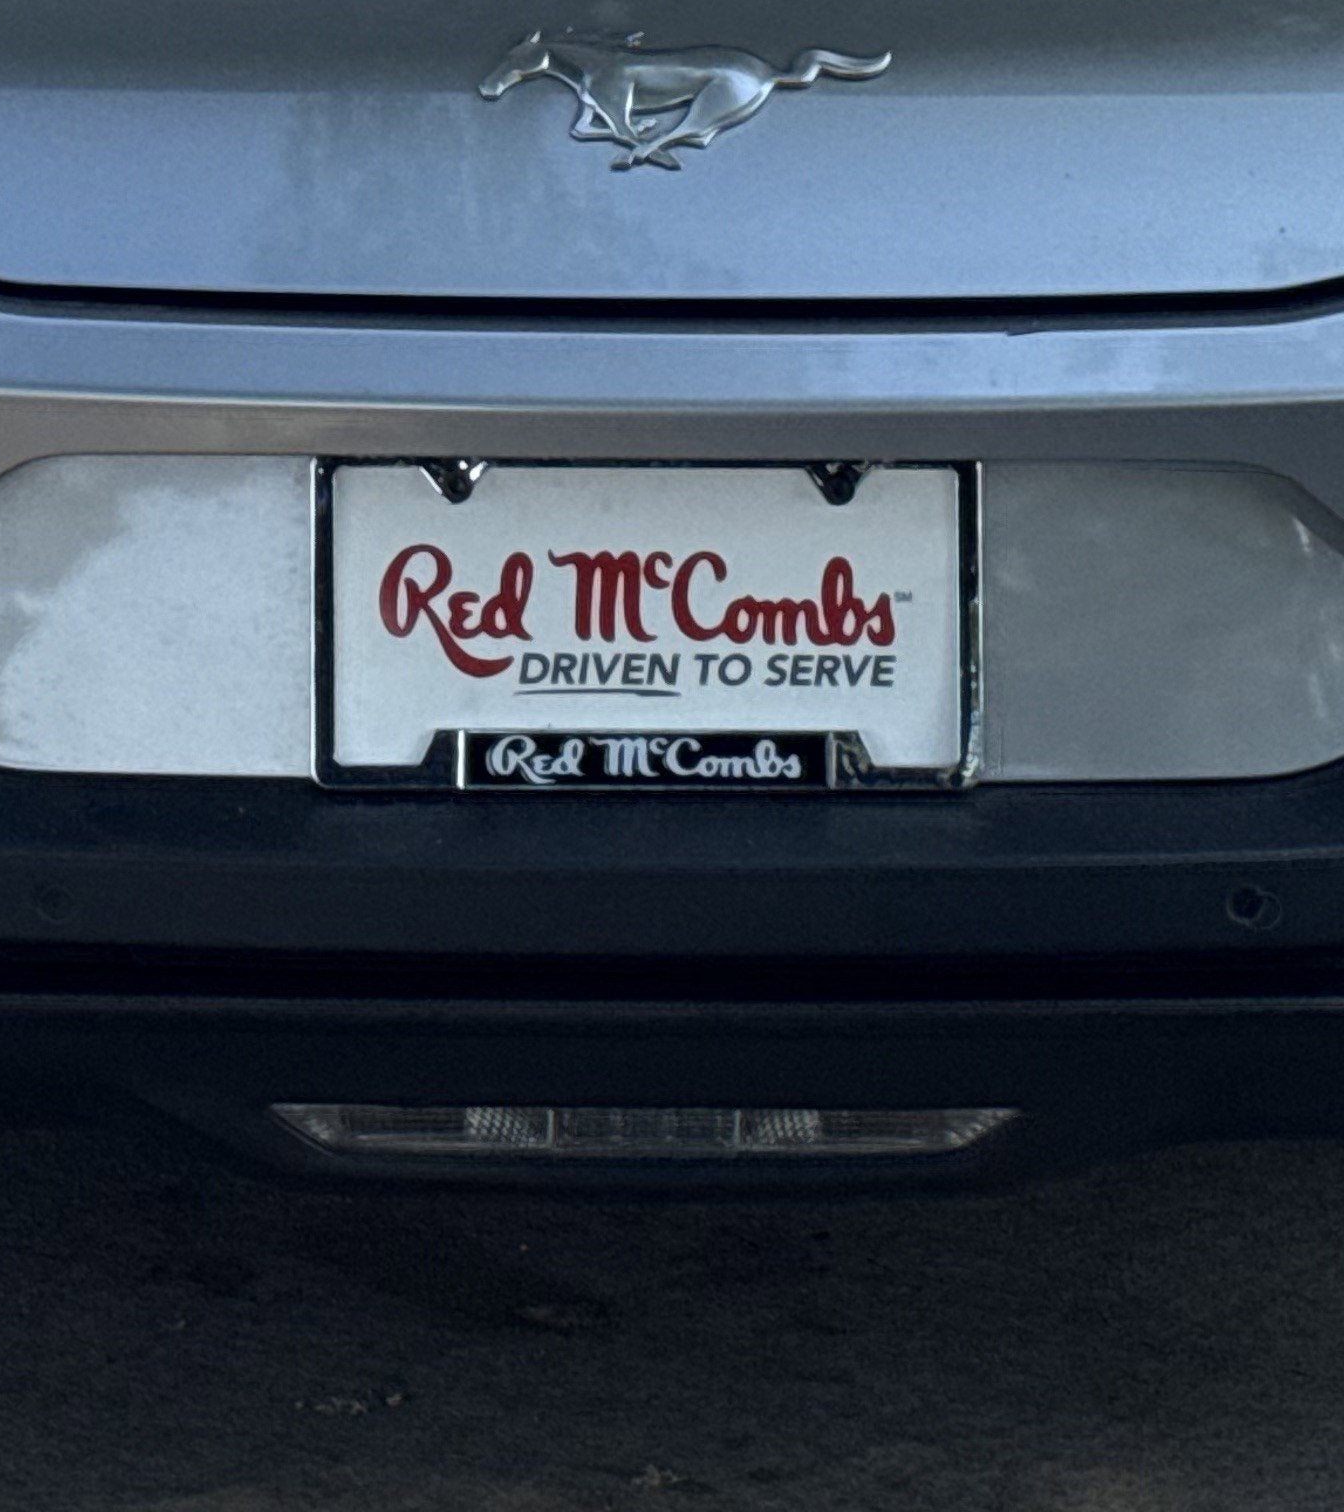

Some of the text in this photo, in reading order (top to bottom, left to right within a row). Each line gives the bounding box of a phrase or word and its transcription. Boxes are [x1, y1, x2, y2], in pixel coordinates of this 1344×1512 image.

[379, 544, 533, 678] Red
[549, 549, 896, 646] McCombs
[518, 653, 897, 687] DRIVEN TO SERVE
[486, 735, 802, 784] Red McCombs
